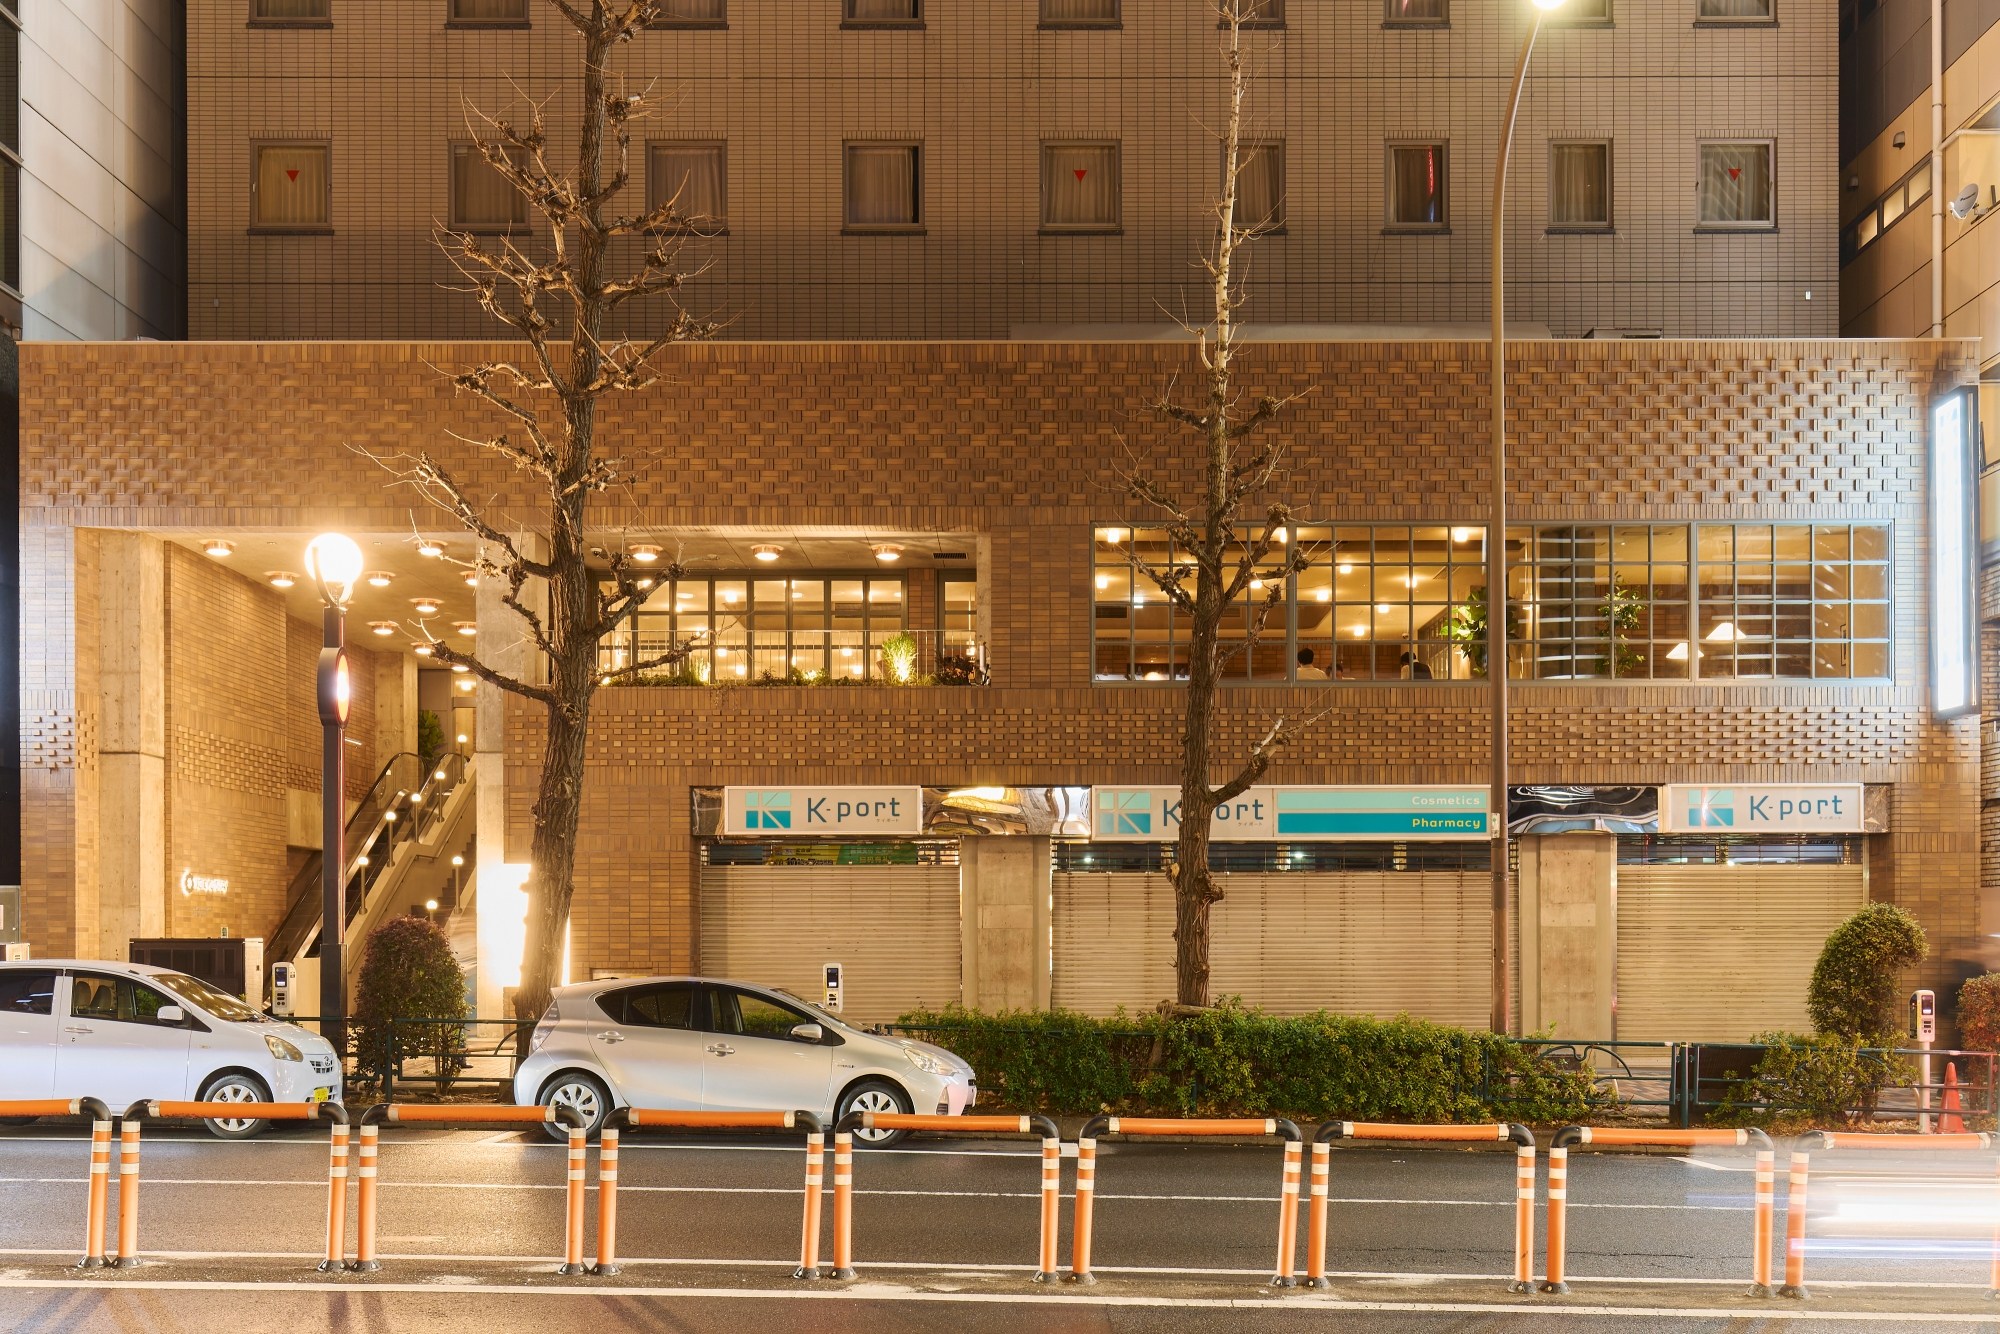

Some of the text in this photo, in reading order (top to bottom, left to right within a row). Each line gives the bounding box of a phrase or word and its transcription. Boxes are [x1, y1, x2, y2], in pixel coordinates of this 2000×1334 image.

[807, 797, 900, 823] K-port
[1163, 799, 1264, 827] Kort
[1412, 795, 1481, 806] Cosmetics
[1750, 795, 1843, 821] K-port
[1412, 818, 1481, 830] Pharmacy
